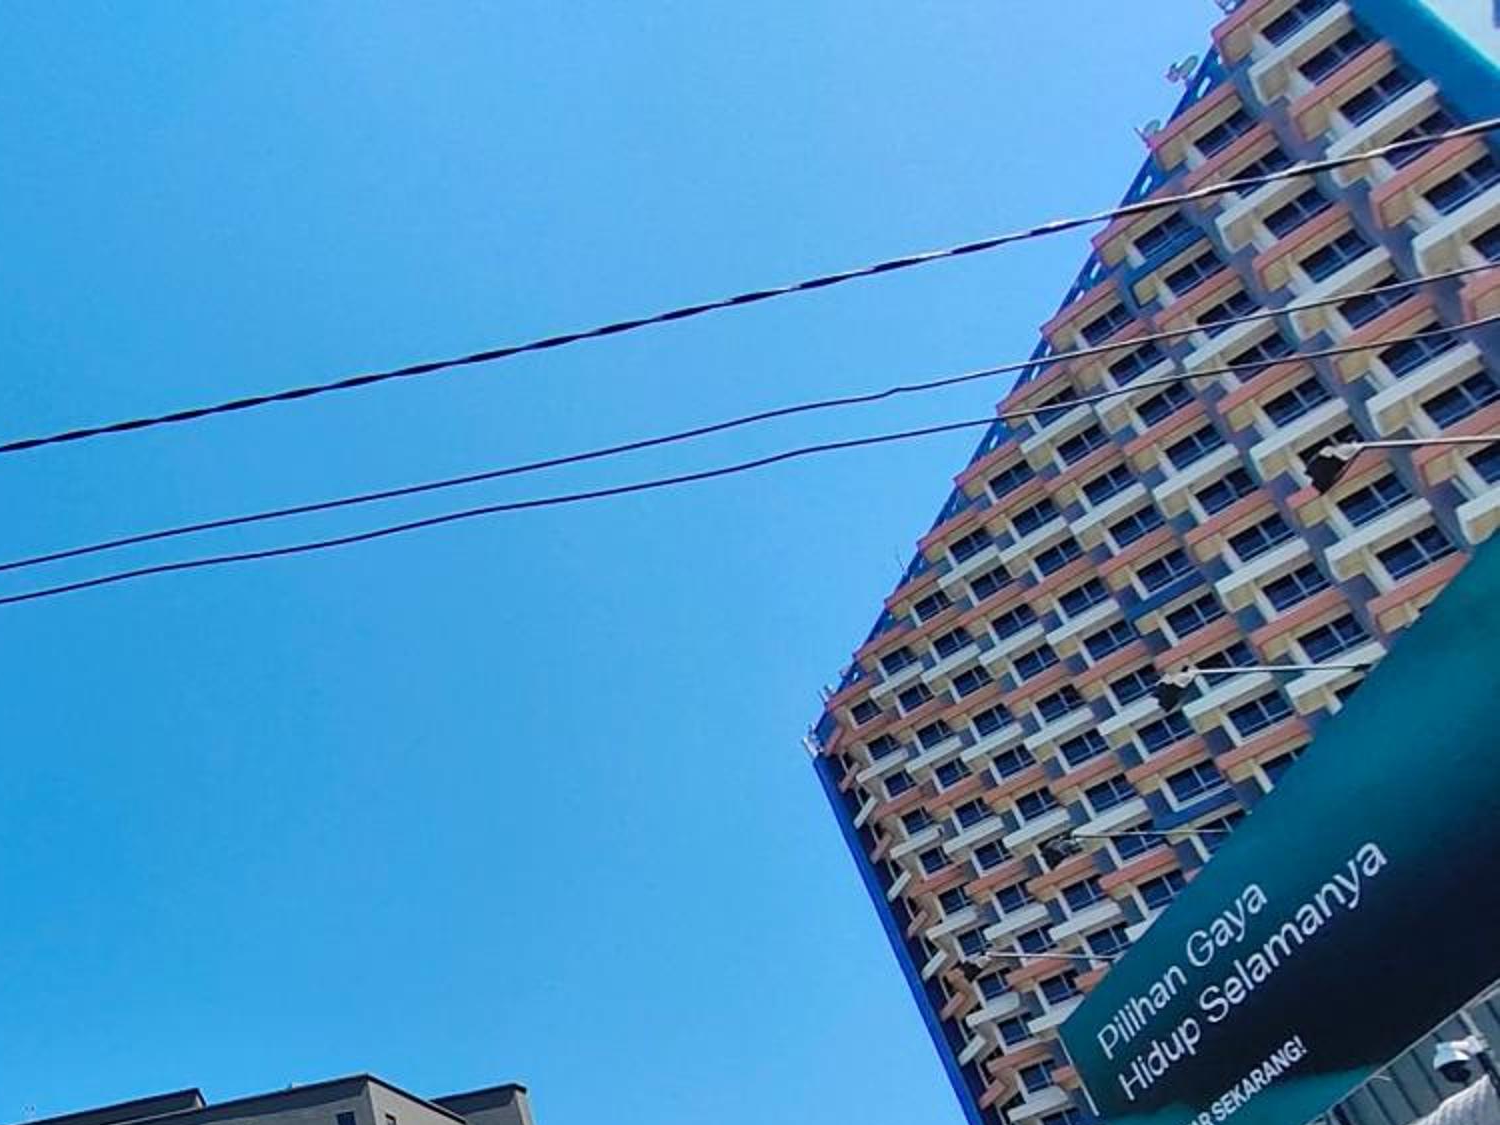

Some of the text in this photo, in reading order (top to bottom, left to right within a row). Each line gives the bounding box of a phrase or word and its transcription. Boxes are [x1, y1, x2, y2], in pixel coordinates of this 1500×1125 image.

[1097, 882, 1269, 1060] Pilihan Gaya
[1117, 840, 1389, 1101] Hidup Selamanya
[1210, 1034, 1308, 1123] SEKARANG!
